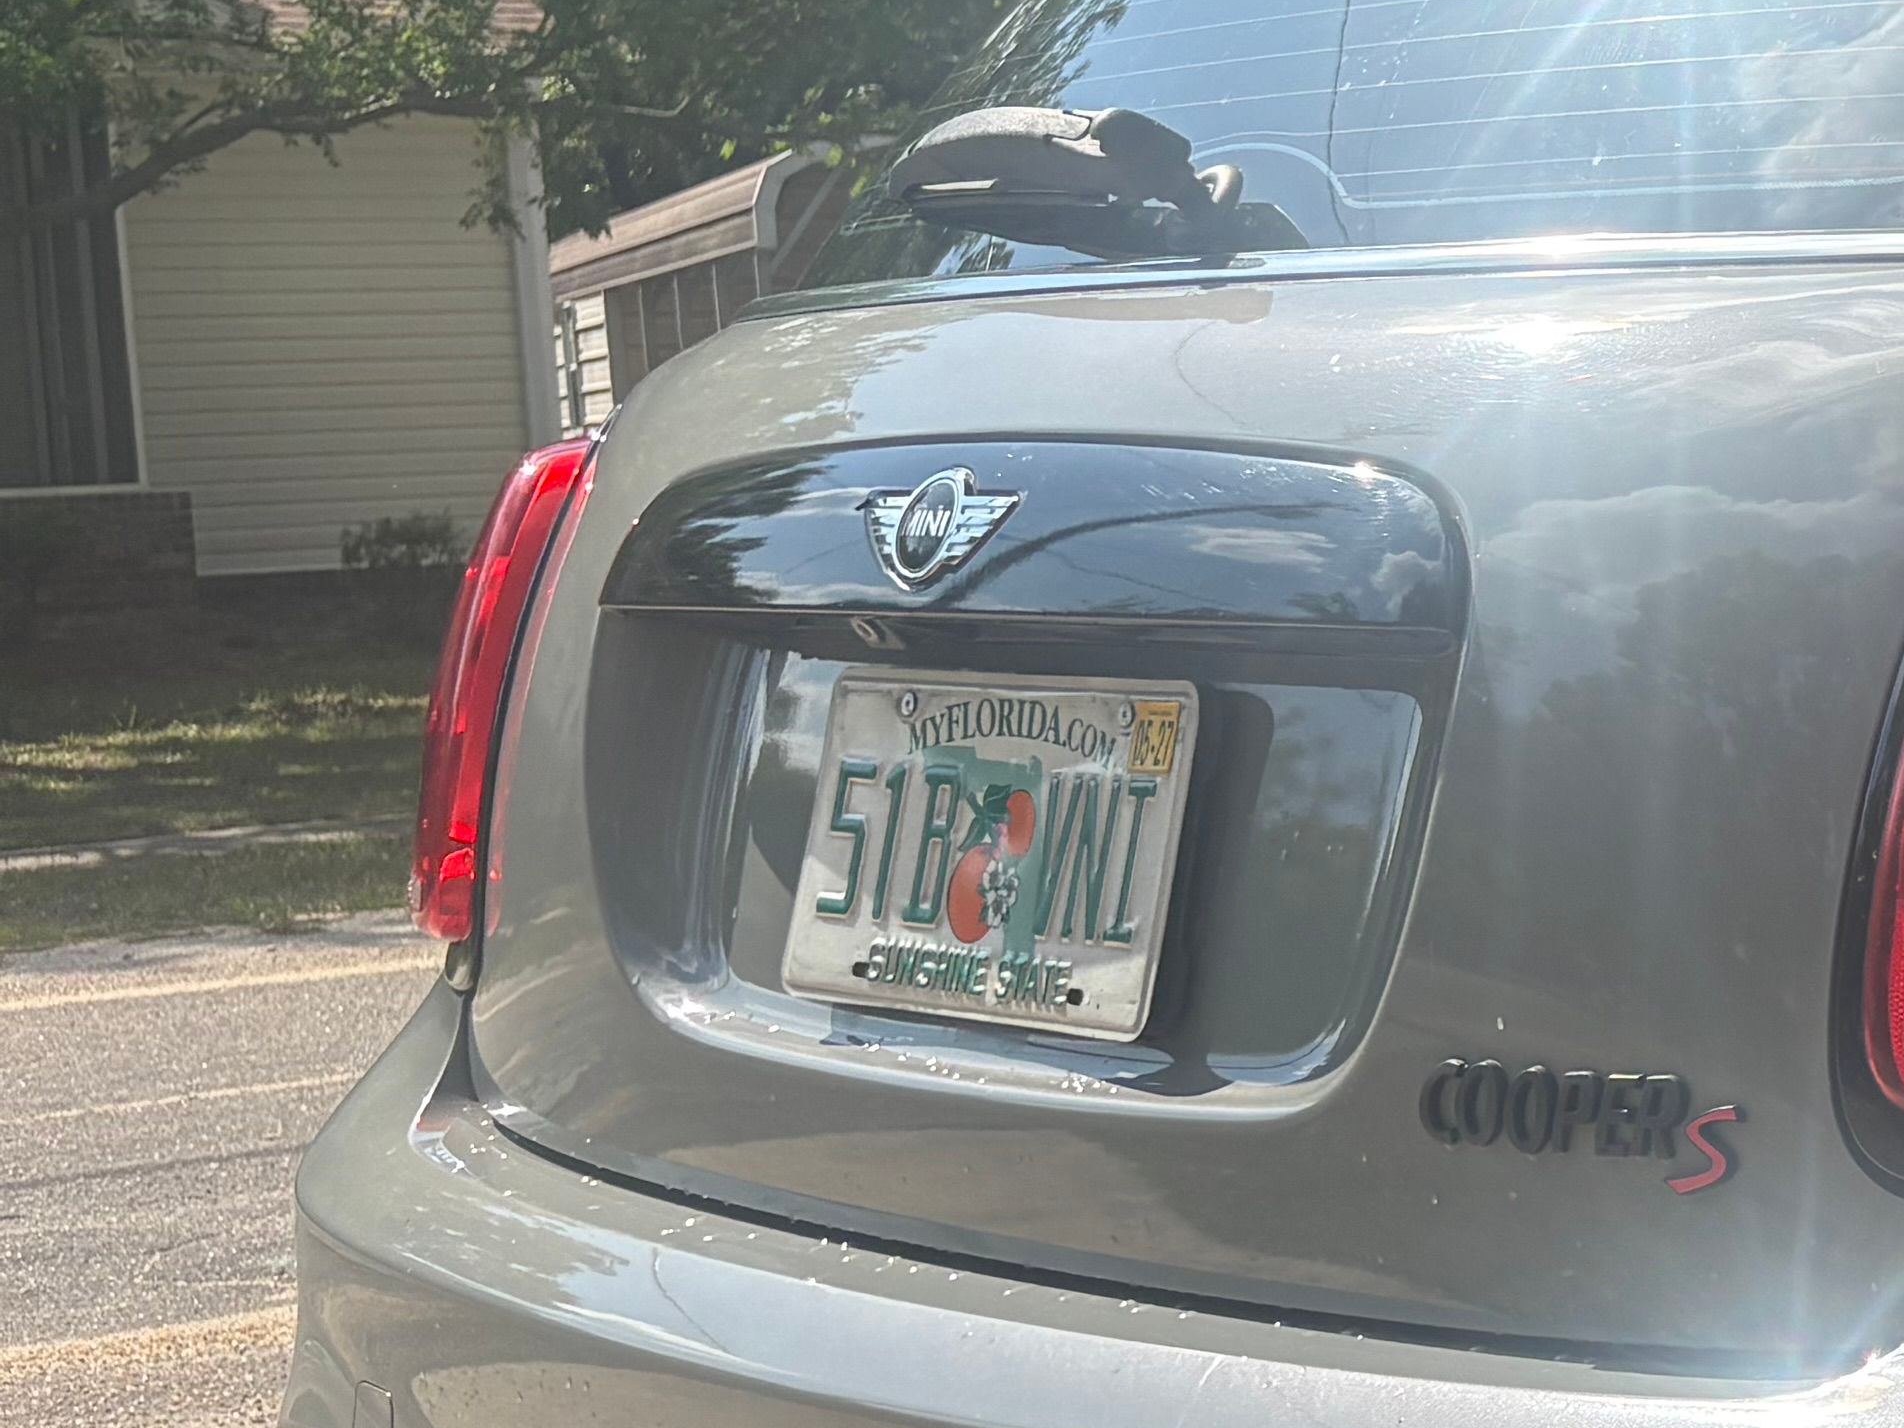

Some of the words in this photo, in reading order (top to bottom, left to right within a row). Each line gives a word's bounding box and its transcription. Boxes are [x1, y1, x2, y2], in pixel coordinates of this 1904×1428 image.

[901, 507, 951, 537] MINI
[907, 697, 1117, 770] MYFLORIDA.COM
[815, 756, 962, 925] 51B
[867, 936, 991, 997] SUNSHINE
[995, 951, 1073, 1006] STATE
[1418, 1057, 1692, 1160] COOPER
[1663, 1104, 1742, 1195] S
